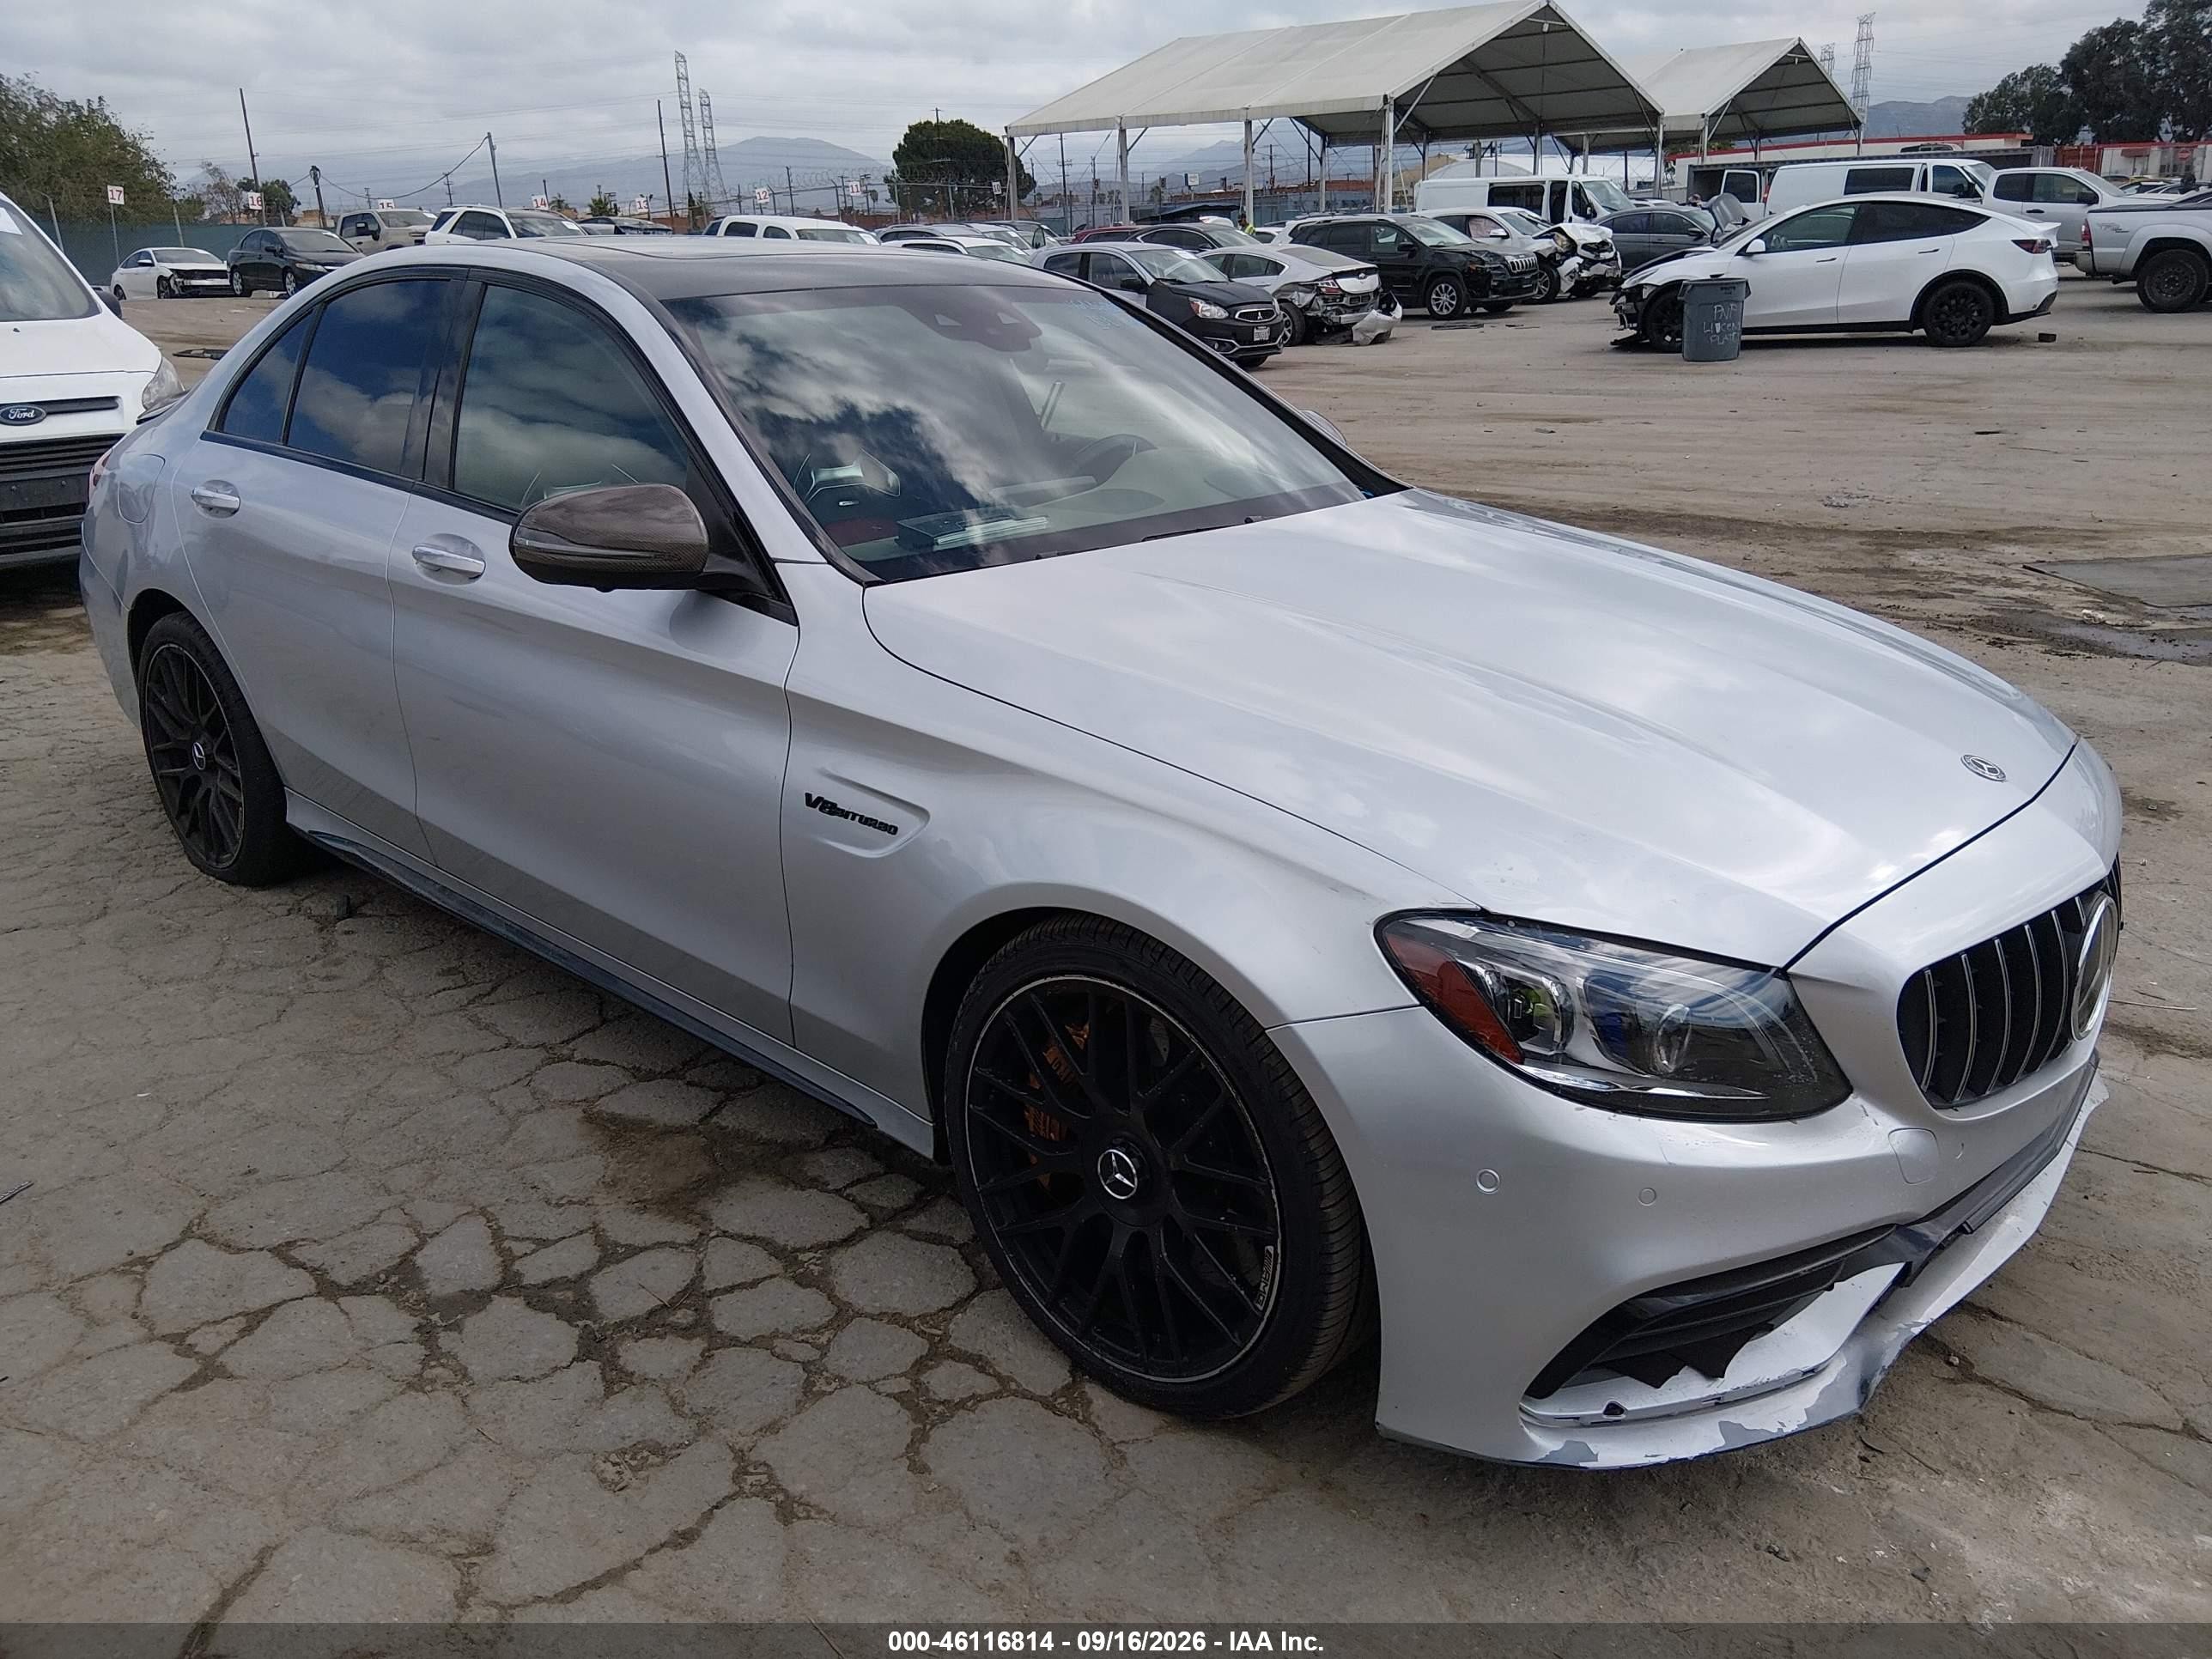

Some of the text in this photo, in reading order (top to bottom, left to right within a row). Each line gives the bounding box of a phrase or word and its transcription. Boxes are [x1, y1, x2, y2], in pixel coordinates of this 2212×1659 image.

[850, 185, 860, 193] 11
[109, 189, 123, 200] 17
[757, 191, 769, 200] 12
[249, 196, 261, 206] 16
[534, 198, 547, 208] 14
[9, 408, 35, 419] Ford
